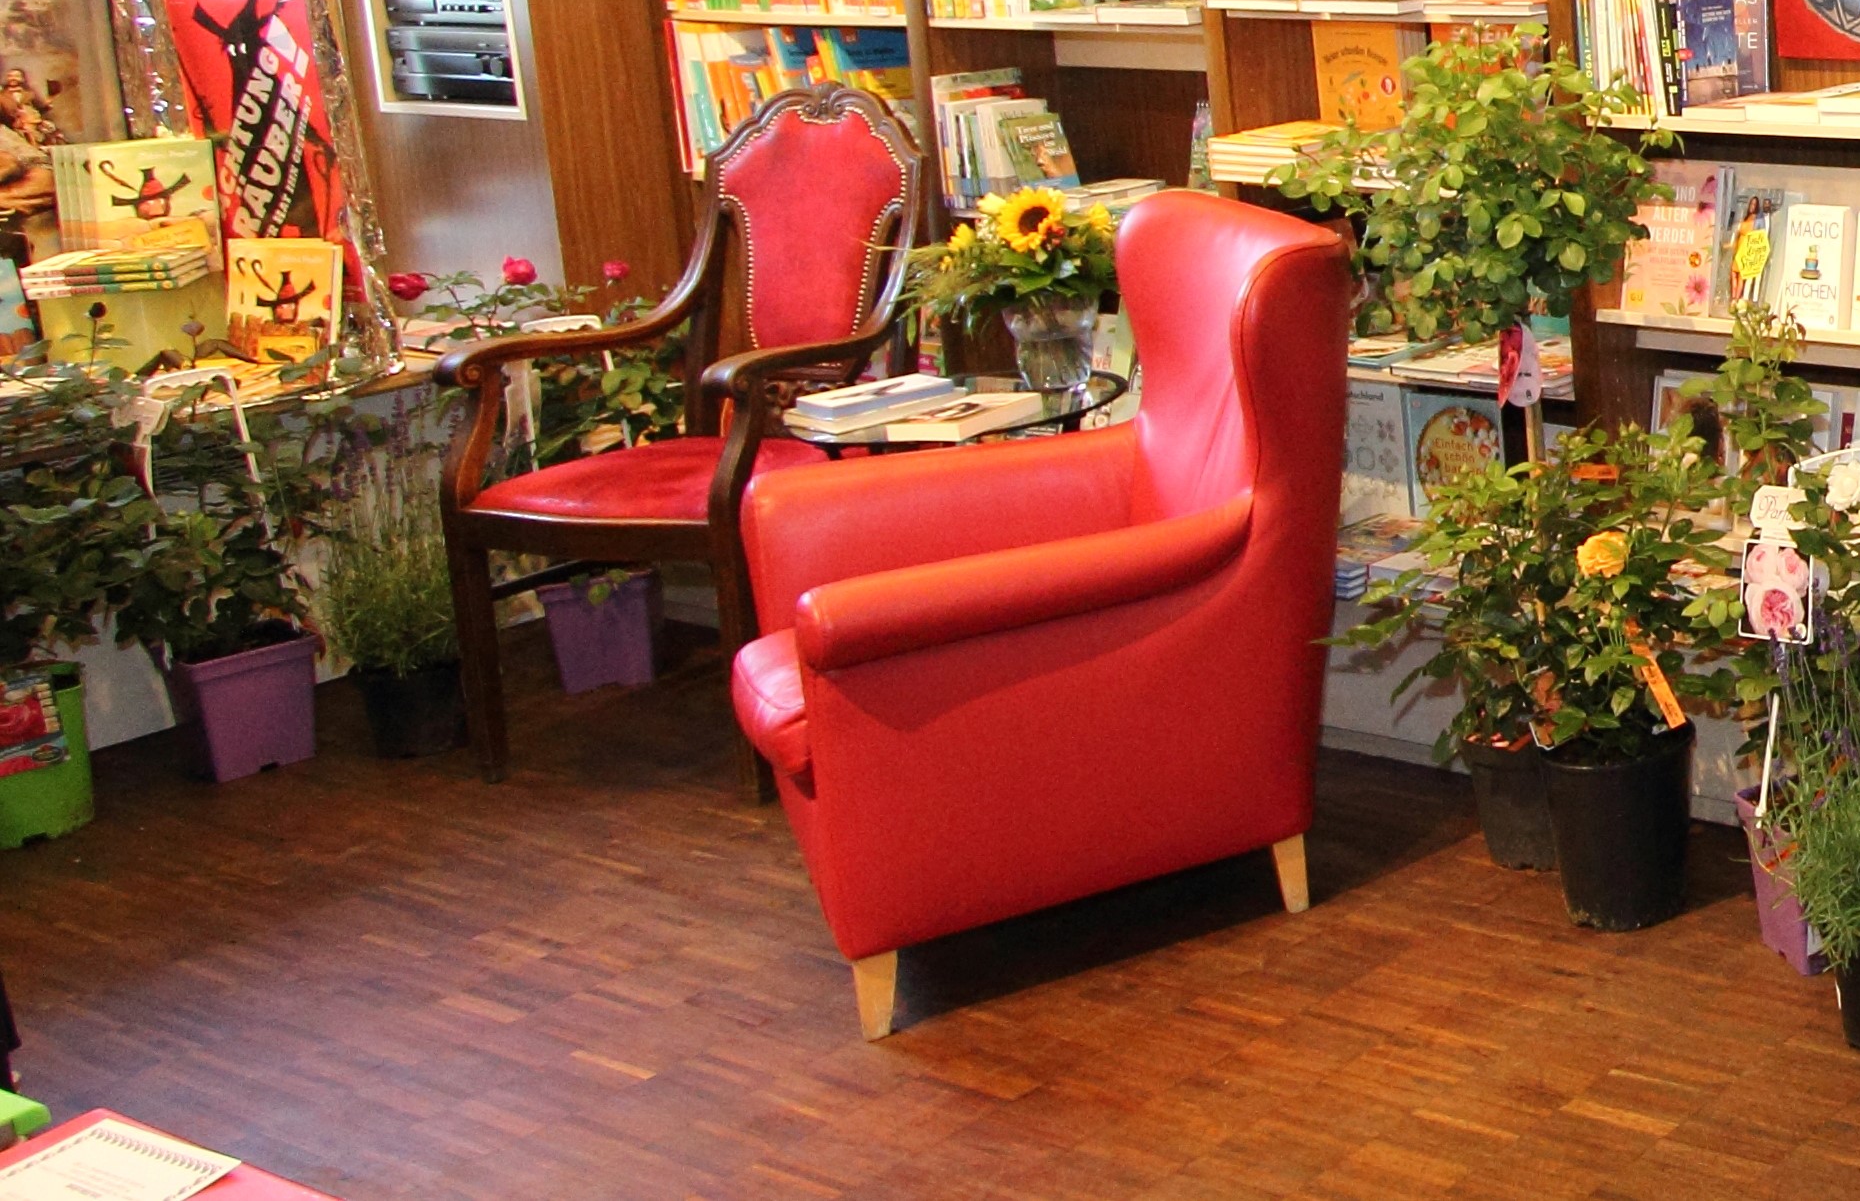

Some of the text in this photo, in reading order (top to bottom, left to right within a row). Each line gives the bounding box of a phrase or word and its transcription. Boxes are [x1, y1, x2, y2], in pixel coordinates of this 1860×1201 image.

[218, 46, 280, 208] CHTUNG
[1653, 206, 1689, 223] ALTER
[1649, 226, 1695, 244] WERDEN
[1790, 220, 1840, 240] MAGIC
[1784, 282, 1837, 300] KITCHEN
[1434, 437, 1475, 451] Einfach
[1444, 451, 1476, 464] schön
